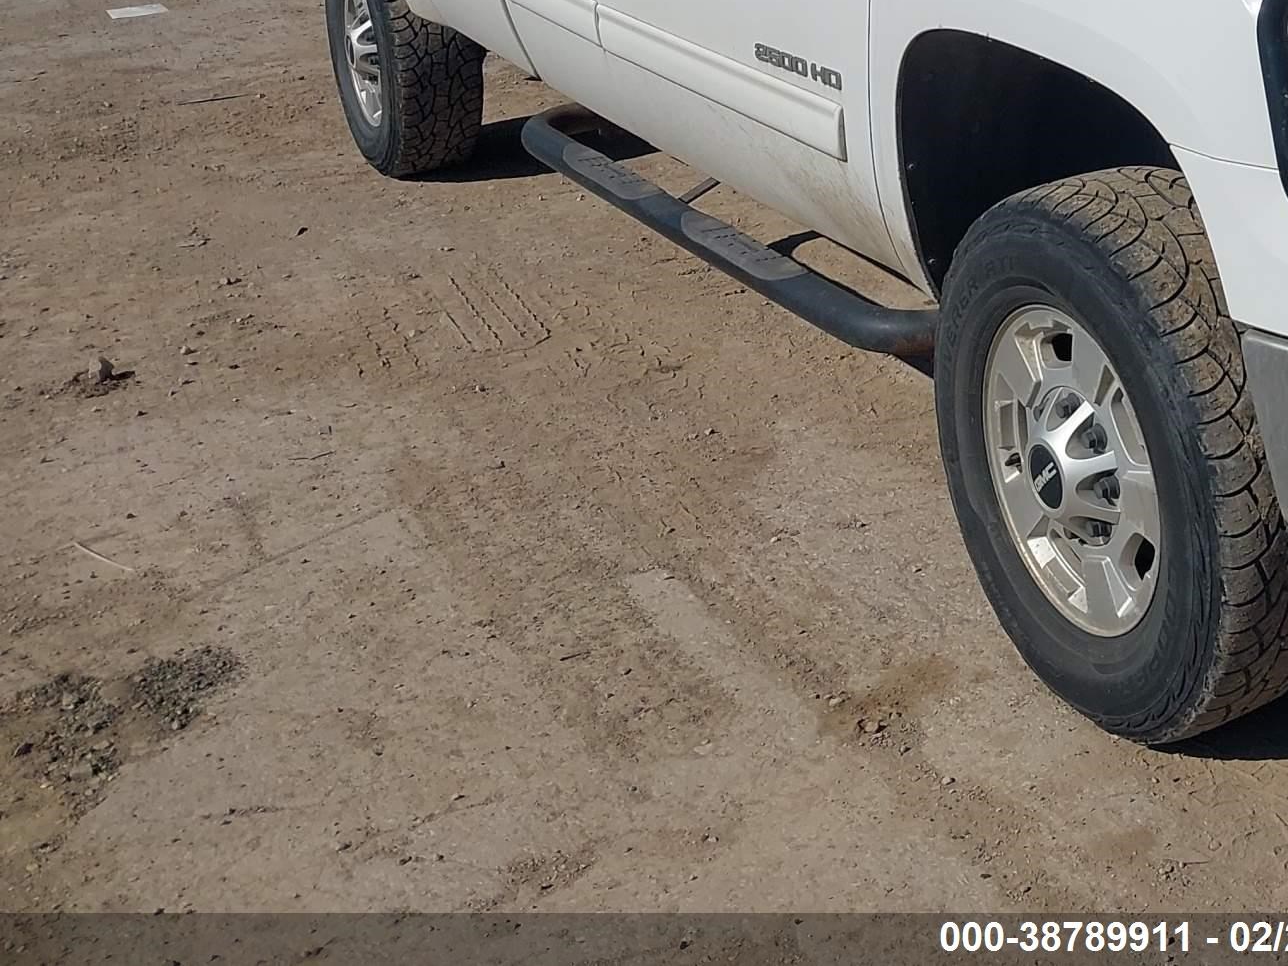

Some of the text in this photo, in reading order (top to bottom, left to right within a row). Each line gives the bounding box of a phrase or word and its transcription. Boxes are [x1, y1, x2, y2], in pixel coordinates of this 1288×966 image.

[754, 42, 843, 91] 2500 HD
[1034, 461, 1057, 492] GMC
